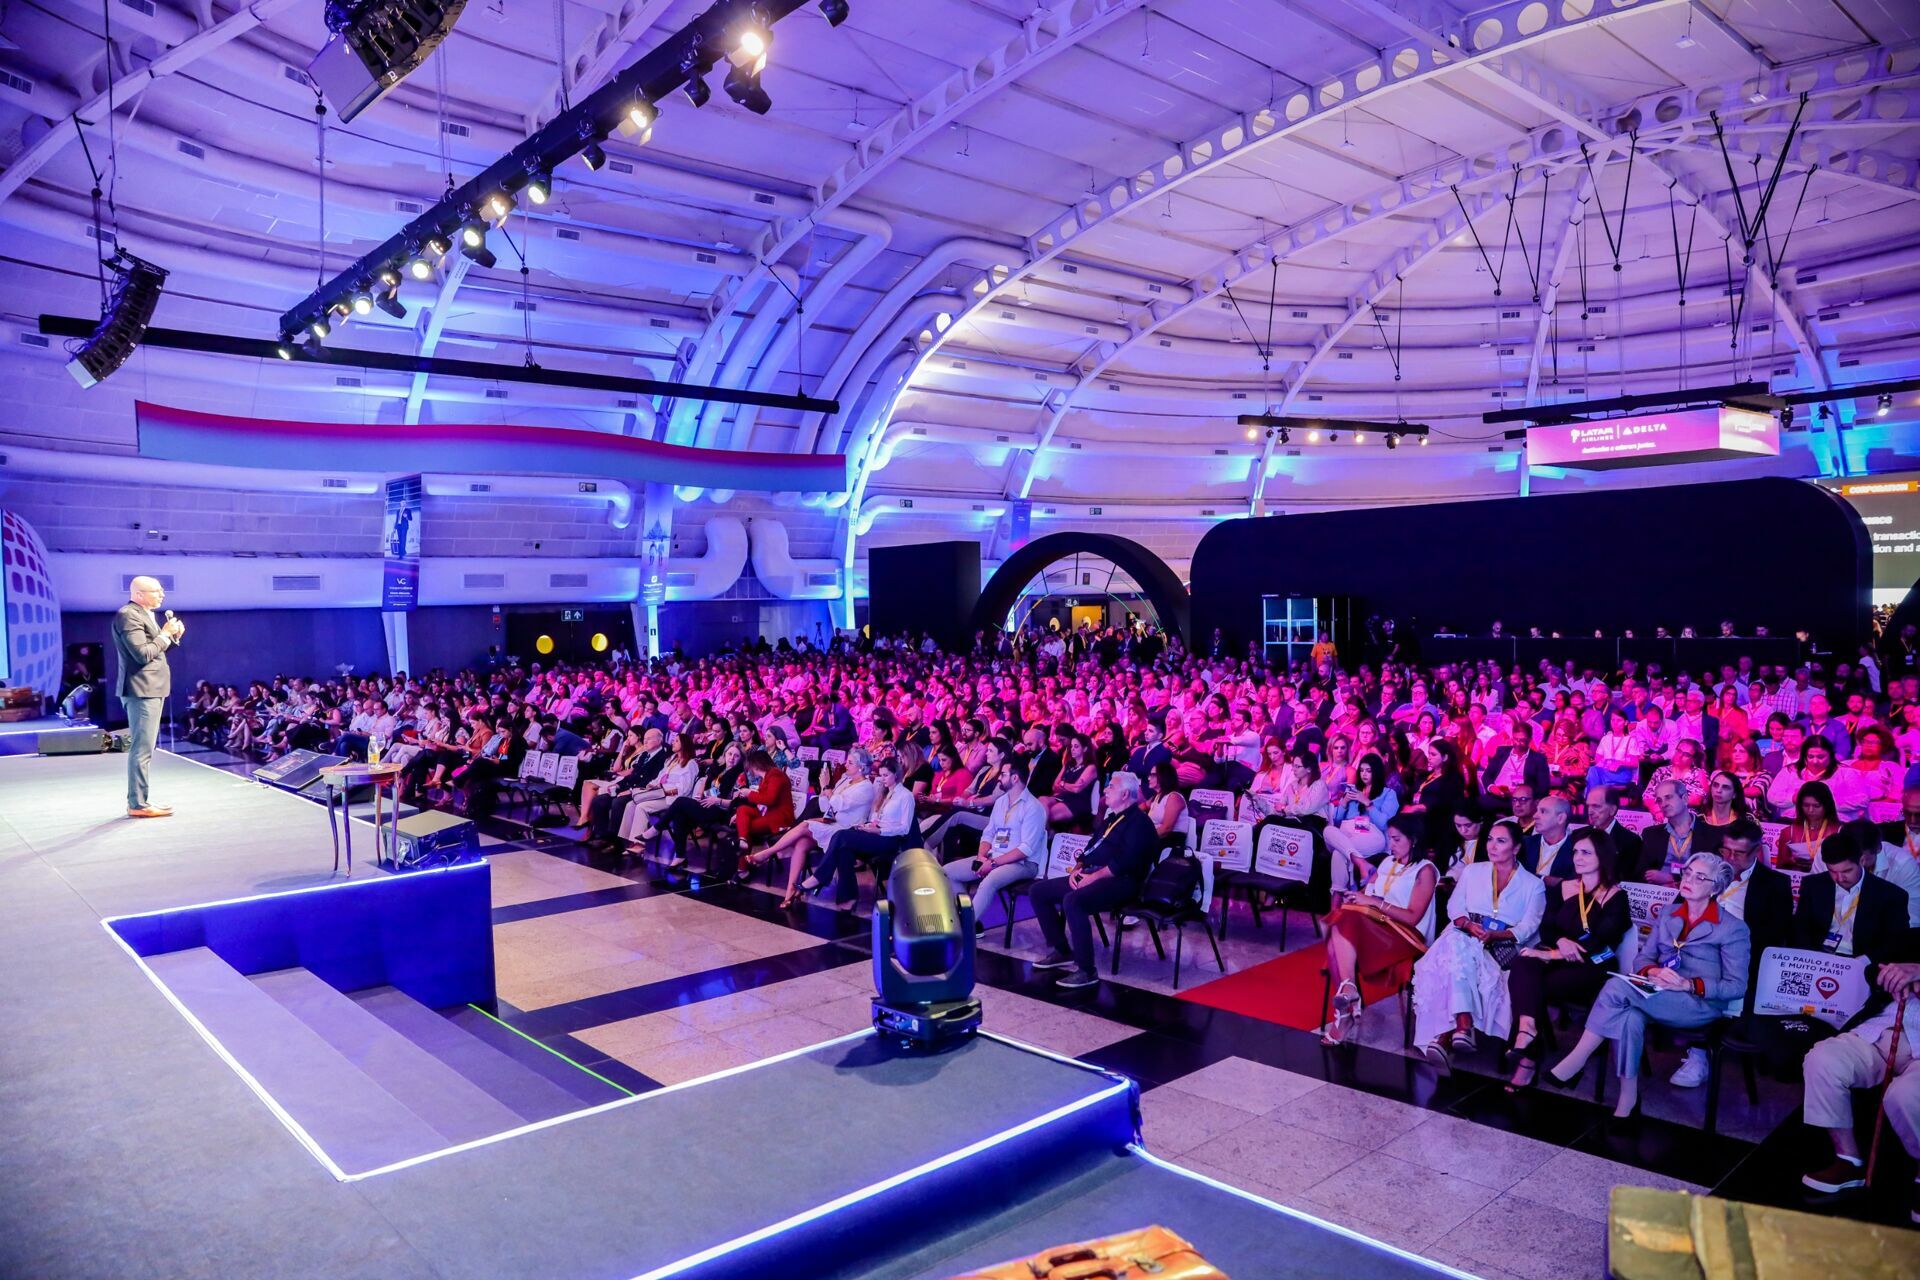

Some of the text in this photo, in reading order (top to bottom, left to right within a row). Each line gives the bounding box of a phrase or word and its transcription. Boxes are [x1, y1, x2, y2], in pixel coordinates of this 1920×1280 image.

[1581, 423, 1666, 437] LATAM DELTA
[1894, 543, 1914, 553] and
[1630, 891, 1652, 899] MUITO
[1634, 887, 1656, 896] PAULO
[1772, 953, 1790, 961] SÃO
[1793, 956, 1822, 966] PAULO
[1789, 962, 1816, 971] MUITO
[1819, 967, 1843, 976] MAIS!
